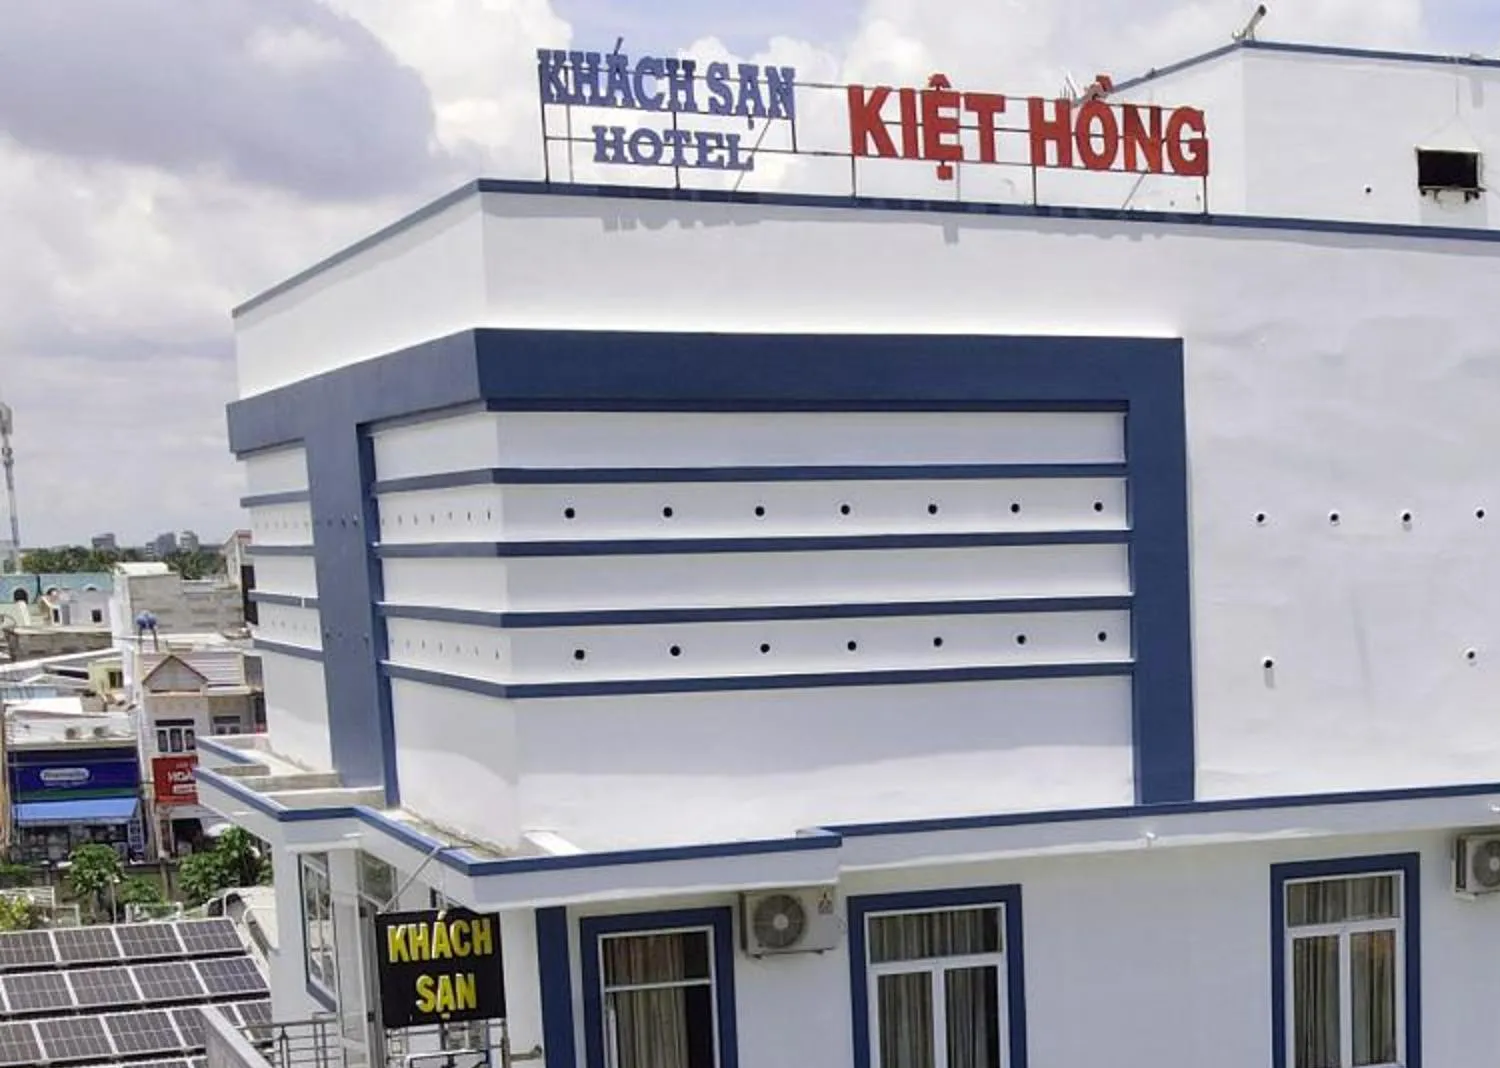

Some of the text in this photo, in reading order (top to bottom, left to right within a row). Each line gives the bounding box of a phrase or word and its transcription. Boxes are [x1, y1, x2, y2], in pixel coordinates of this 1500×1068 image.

[537, 36, 796, 130] KHÁCH SẠN
[591, 125, 754, 171] HOTEL
[847, 73, 1006, 181] KIỆT
[386, 910, 493, 963] KHÁCH
[415, 972, 477, 1019] SẠN
